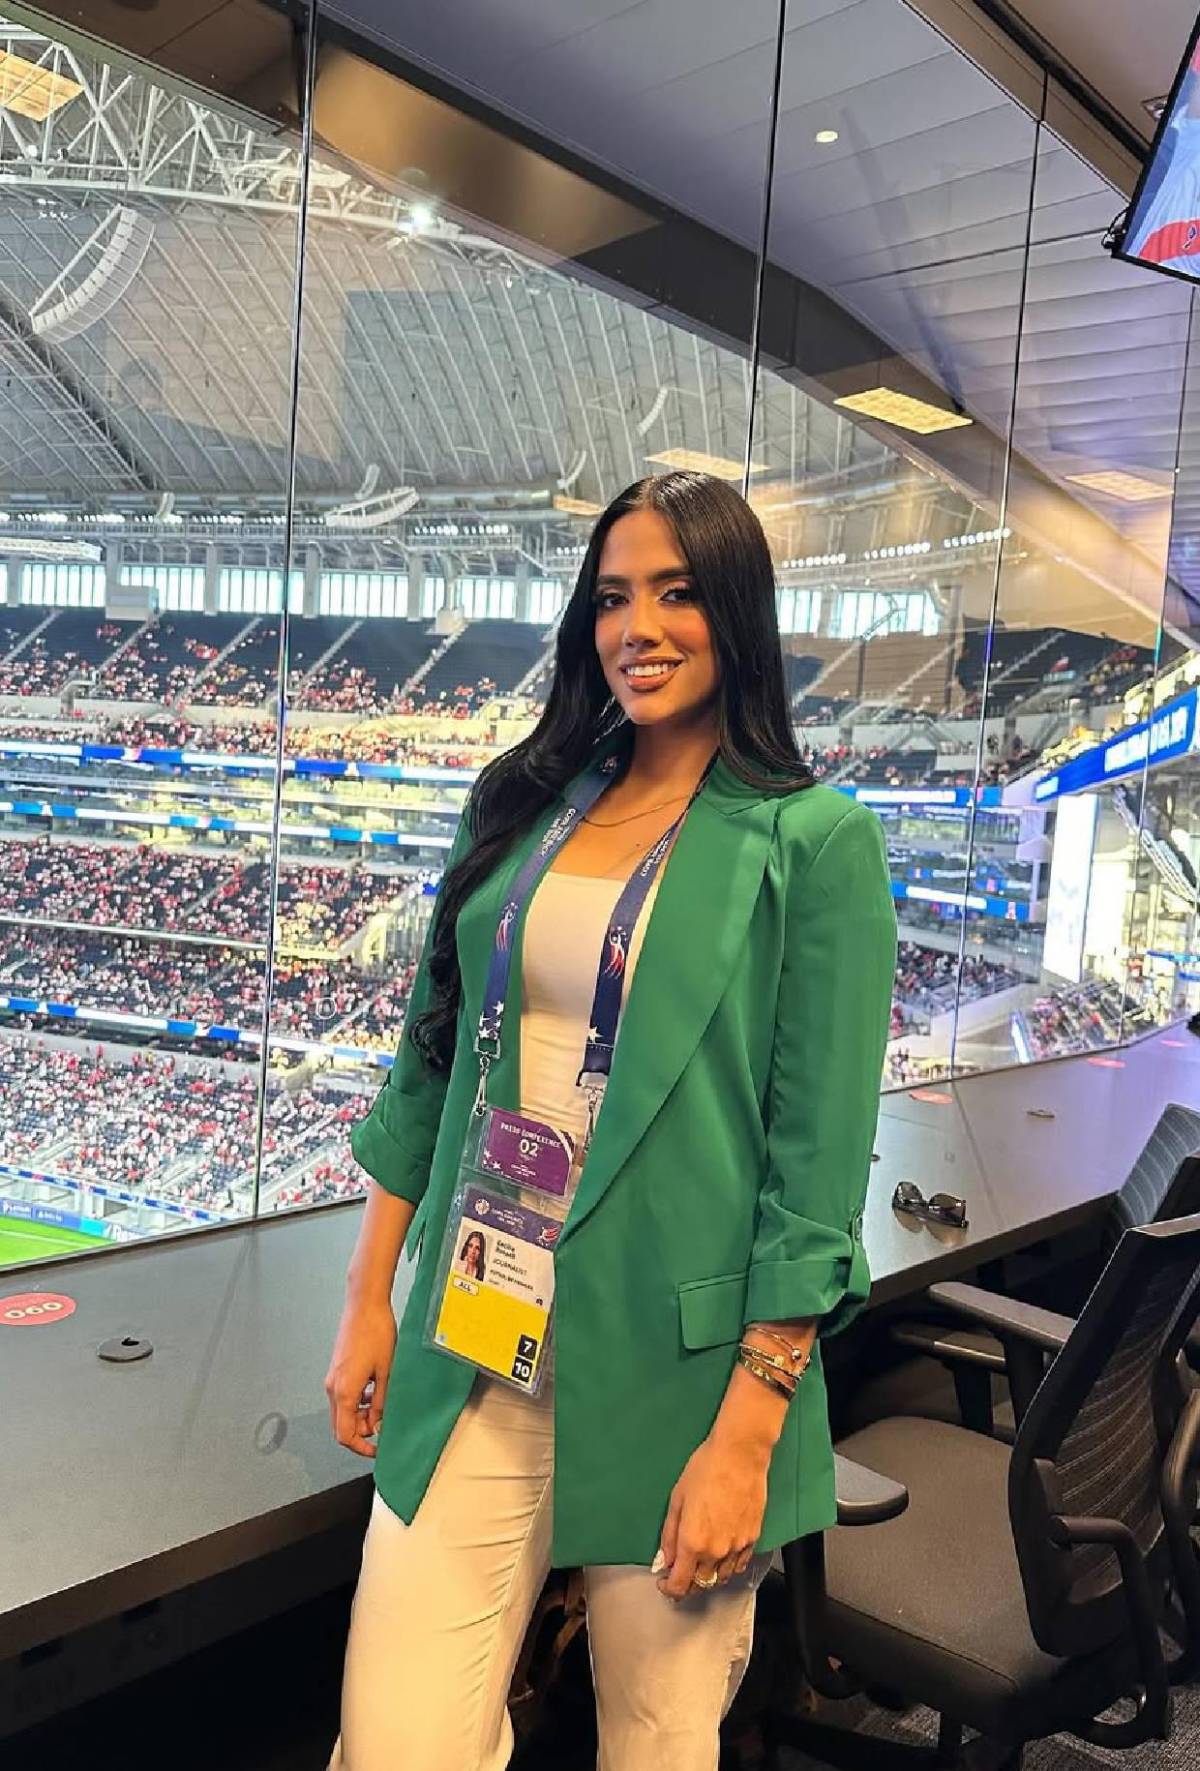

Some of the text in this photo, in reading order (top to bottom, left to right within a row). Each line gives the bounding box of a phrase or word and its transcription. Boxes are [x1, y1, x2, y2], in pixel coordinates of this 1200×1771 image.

[520, 1138, 538, 1157] 02
[523, 1340, 533, 1353] 7
[515, 1361, 530, 1378] 10
